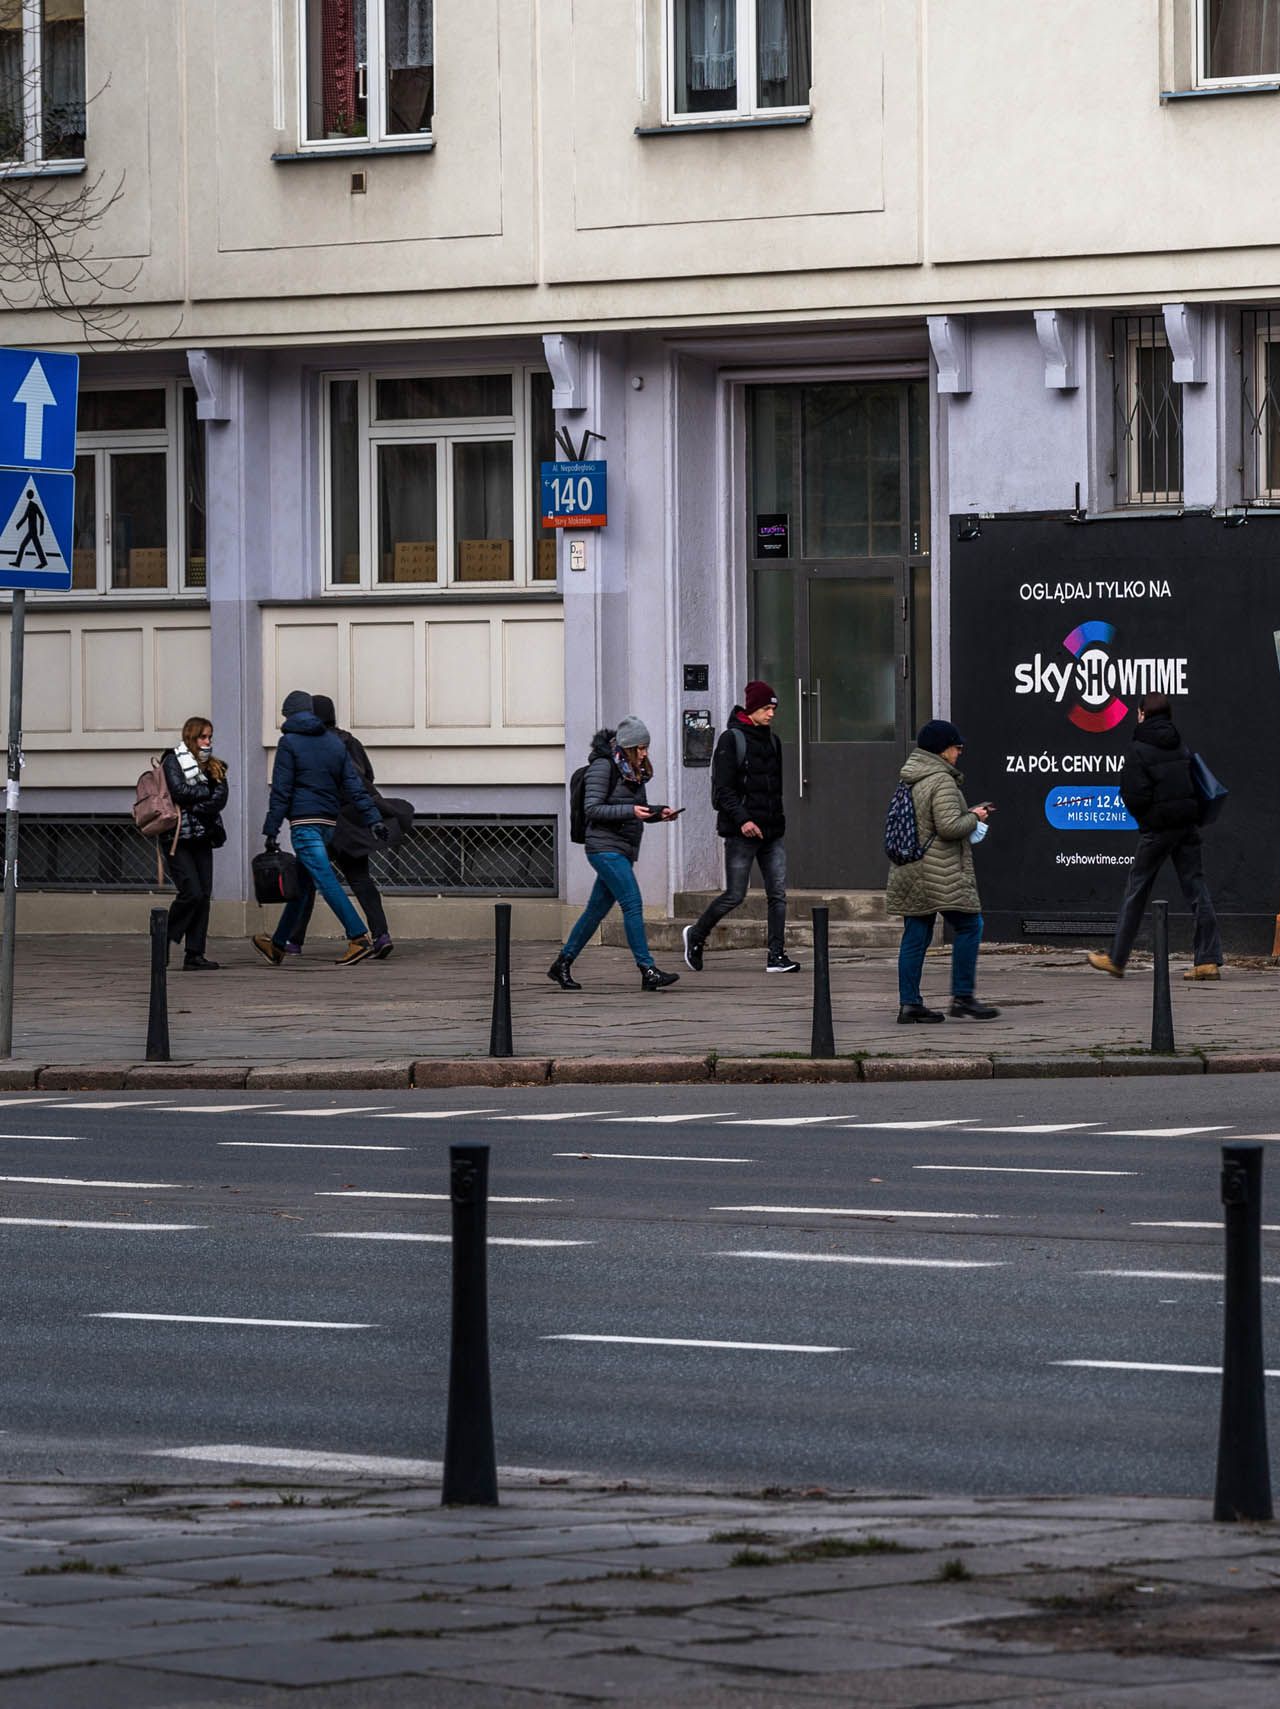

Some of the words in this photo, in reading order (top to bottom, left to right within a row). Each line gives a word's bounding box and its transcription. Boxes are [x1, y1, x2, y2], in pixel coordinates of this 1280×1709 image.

[551, 476, 593, 512] 140
[1019, 581, 1092, 604] OGLĄDAJ
[1095, 580, 1146, 599] TYLKO
[1149, 579, 1172, 598] NA
[1006, 755, 1026, 773] ZA
[1028, 750, 1059, 773] PÓŁ
[1061, 755, 1103, 773] CENY
[1105, 755, 1126, 773] NA
[1067, 811, 1127, 823] MIESIĘCZNIE
